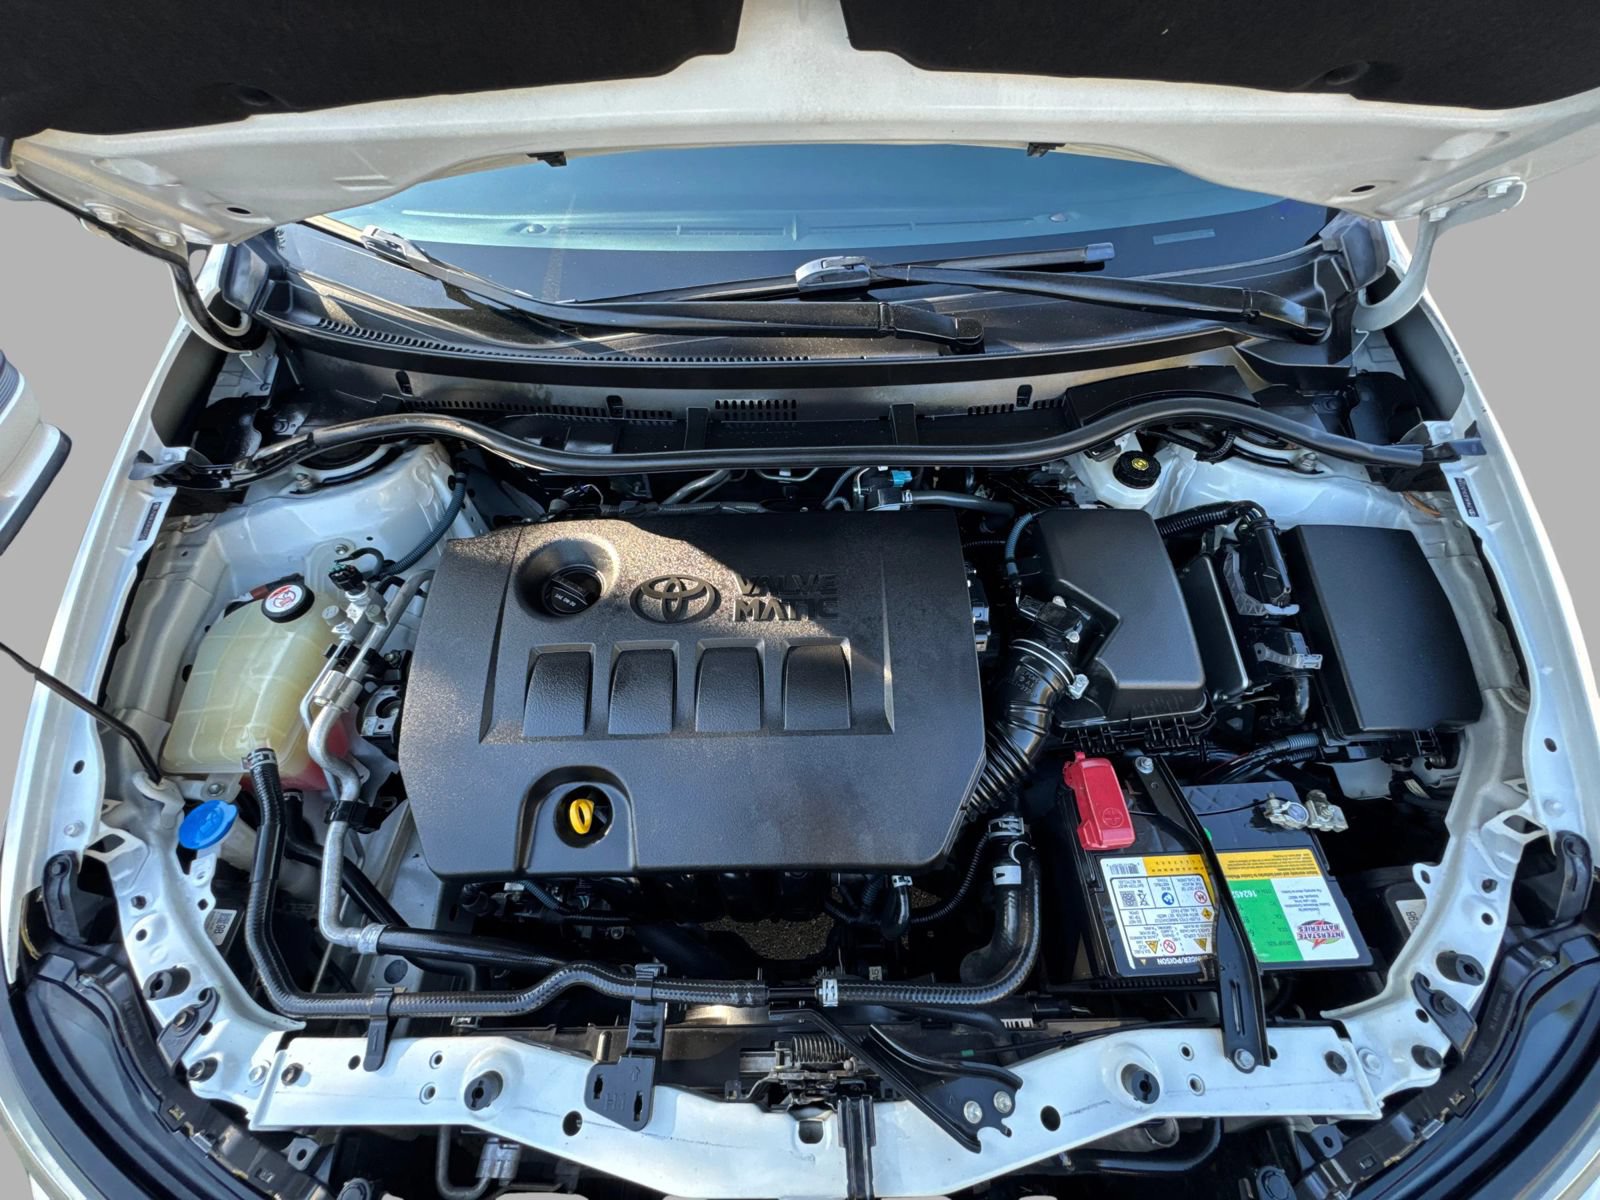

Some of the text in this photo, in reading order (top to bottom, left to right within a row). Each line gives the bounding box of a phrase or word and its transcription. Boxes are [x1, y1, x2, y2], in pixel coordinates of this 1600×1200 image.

[733, 574, 837, 596] VALVE
[733, 598, 839, 621] MATIC
[1298, 923, 1340, 932] BATTERIES
[1297, 931, 1344, 941] INTERSTATE
